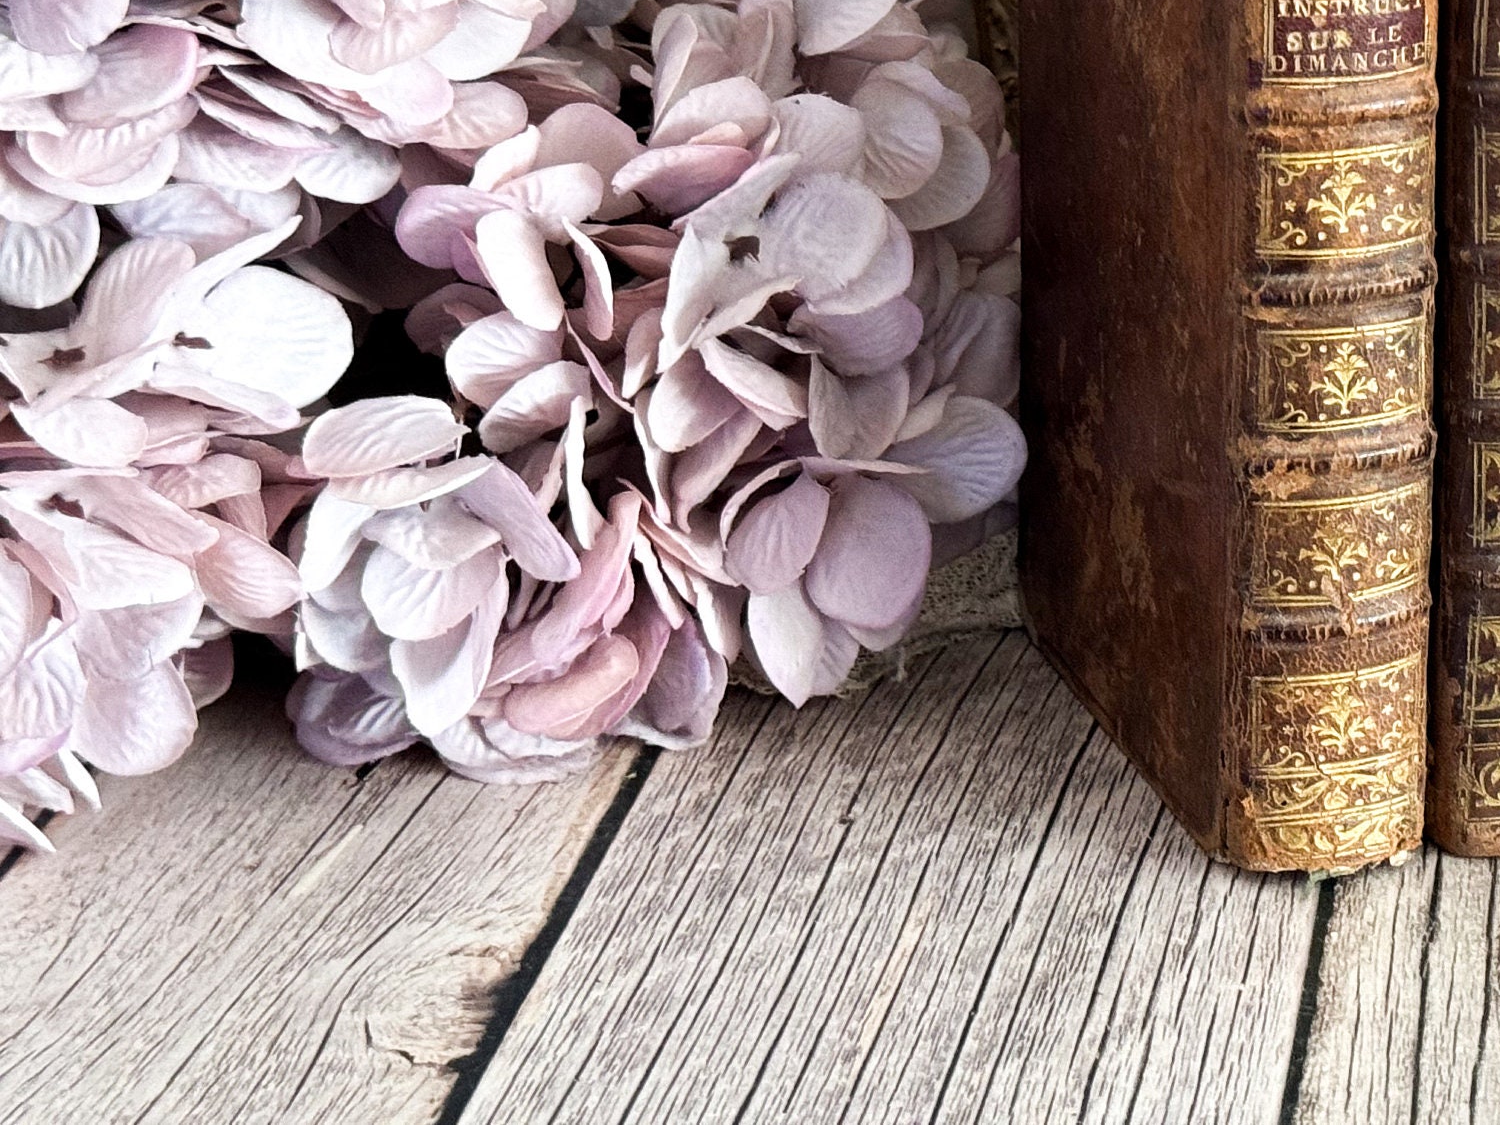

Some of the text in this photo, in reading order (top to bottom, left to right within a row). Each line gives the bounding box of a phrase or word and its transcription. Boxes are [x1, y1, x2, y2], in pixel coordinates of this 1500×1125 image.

[1287, 22, 1402, 52] SUR LE
[1270, 42, 1425, 72] DIMANCHE
